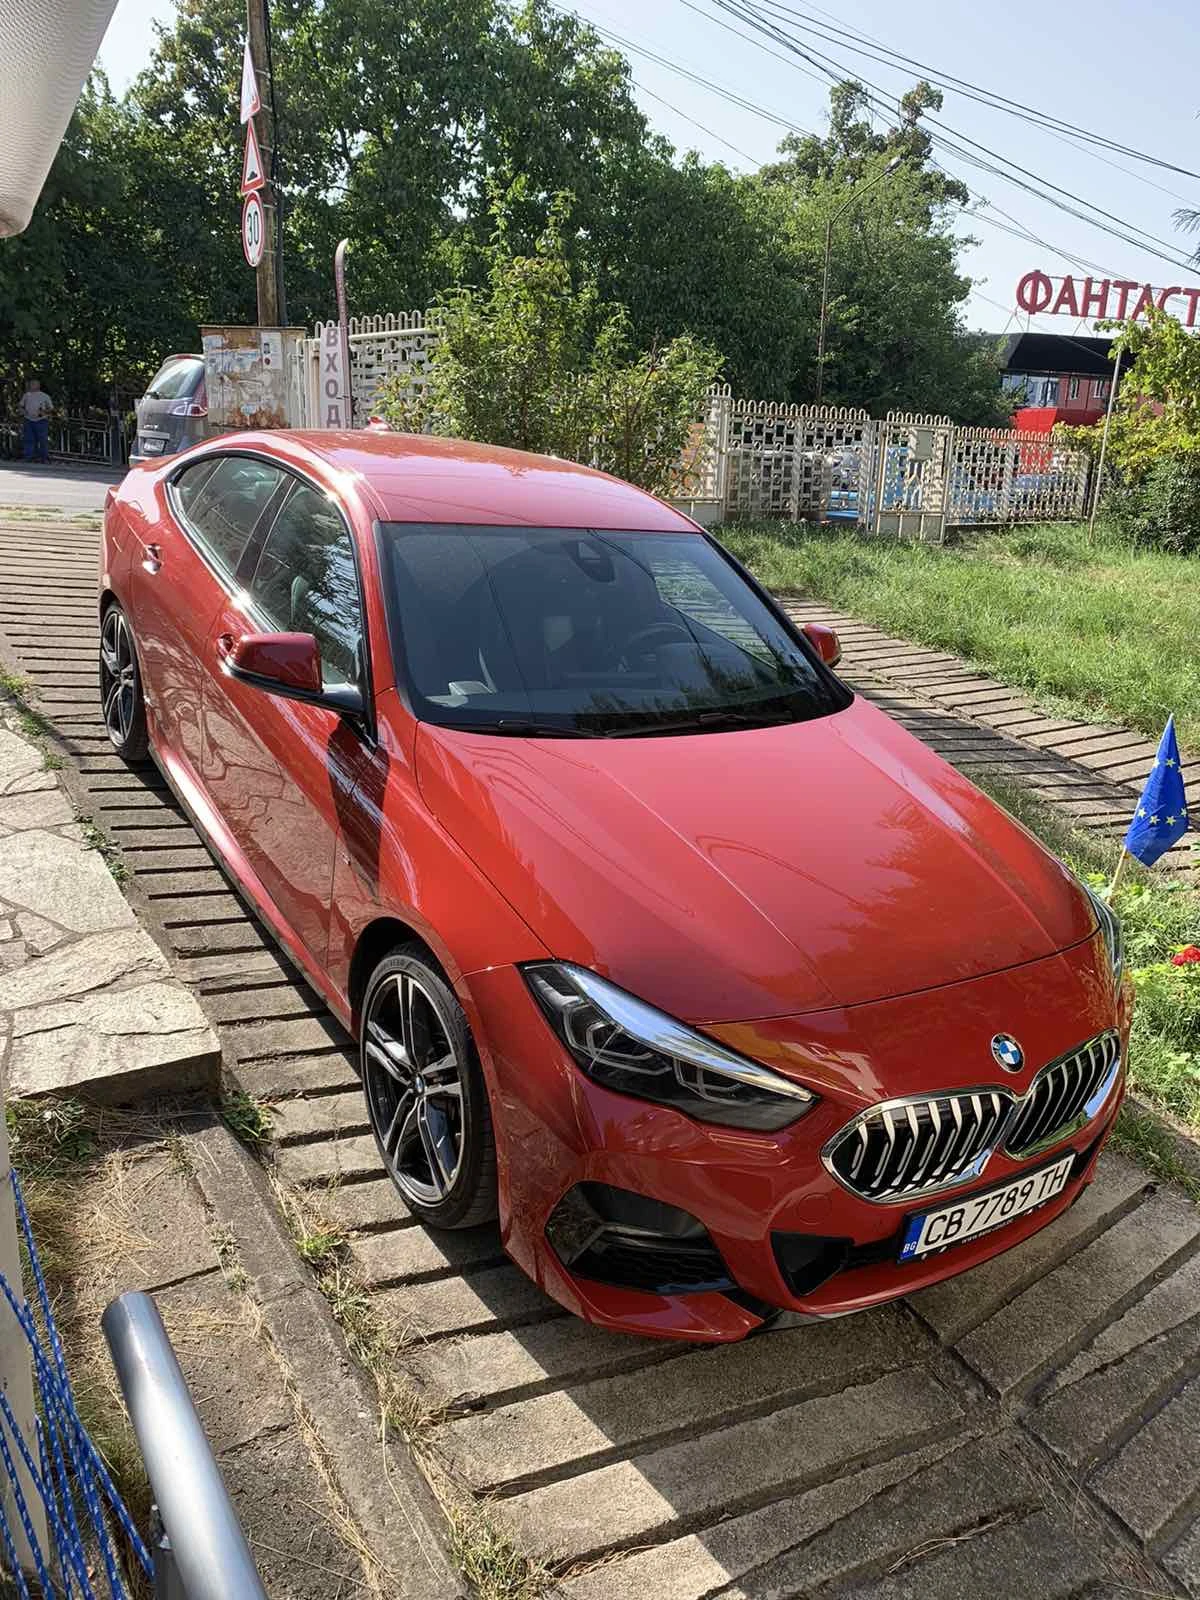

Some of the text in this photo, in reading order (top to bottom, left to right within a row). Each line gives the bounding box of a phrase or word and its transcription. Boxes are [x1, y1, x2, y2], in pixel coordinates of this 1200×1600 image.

[247, 211, 259, 247] 30
[325, 328, 341, 429] ВХОД
[924, 1207, 965, 1246] CB
[966, 1180, 1034, 1232] 7789
[1038, 1161, 1069, 1199] TH
[903, 1241, 917, 1253] BG
